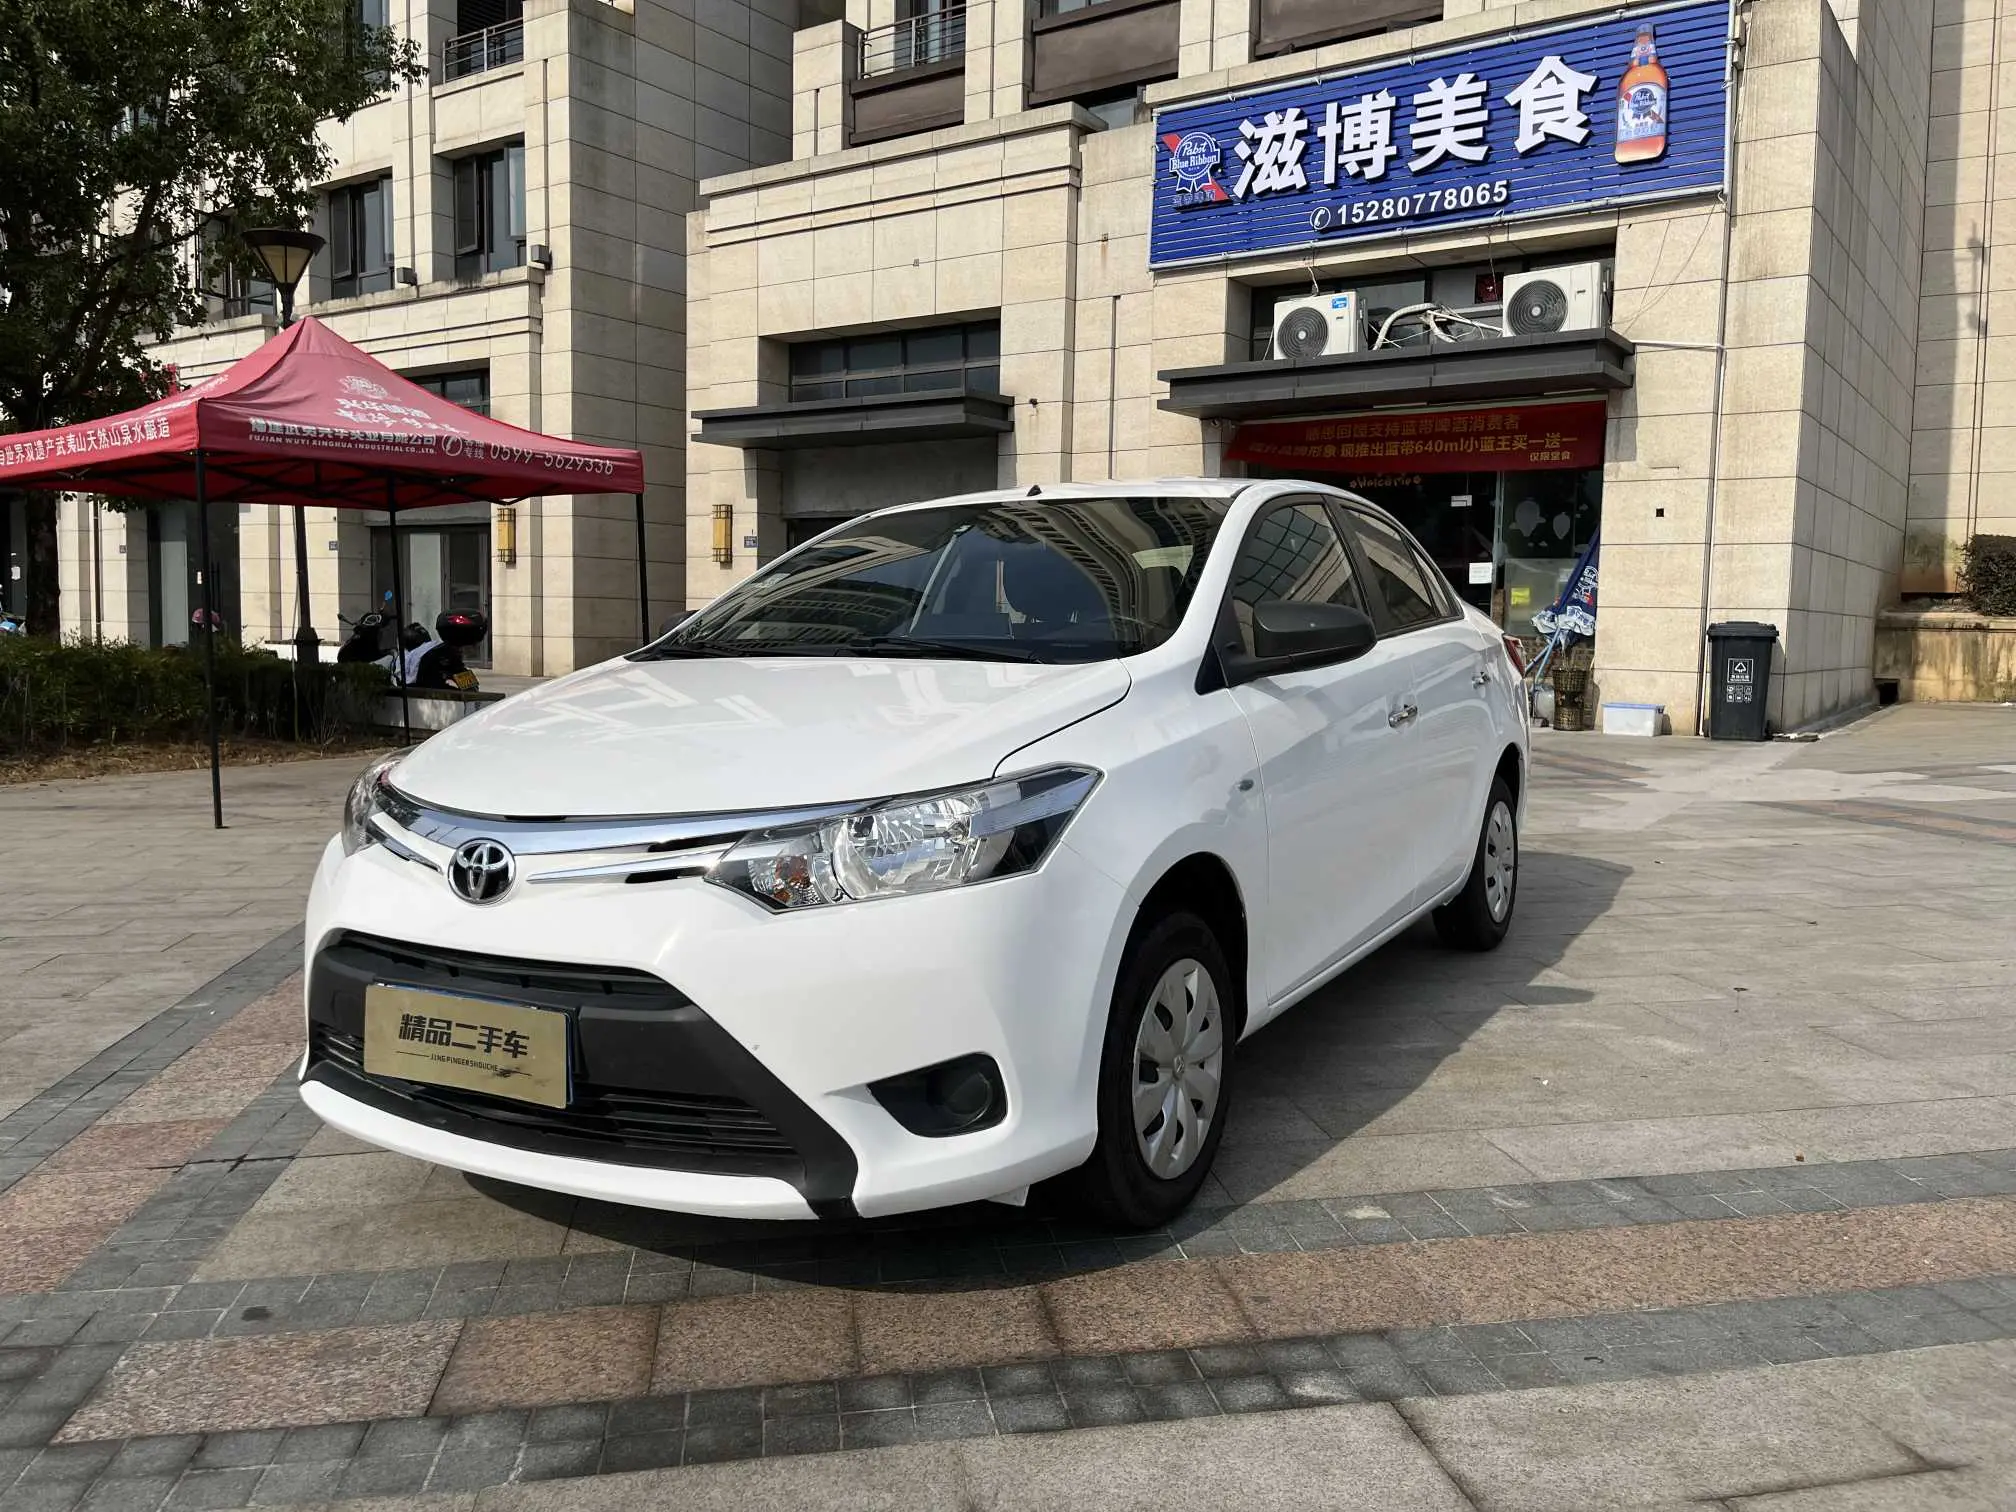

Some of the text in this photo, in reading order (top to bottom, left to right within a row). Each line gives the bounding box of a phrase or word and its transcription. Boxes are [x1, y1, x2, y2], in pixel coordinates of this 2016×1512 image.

[1232, 55, 1599, 199] 滋博美食
[1172, 154, 1217, 170] Blue Ribbon
[1182, 141, 1208, 156] Pabst
[1336, 180, 1509, 225] 15280778065
[249, 434, 283, 444] FUJIAN
[285, 438, 310, 446] WUYI
[312, 440, 353, 449] XINGHUA
[355, 443, 404, 453] INDUSTRIAL
[398, 1013, 530, 1059] 精品二手车
